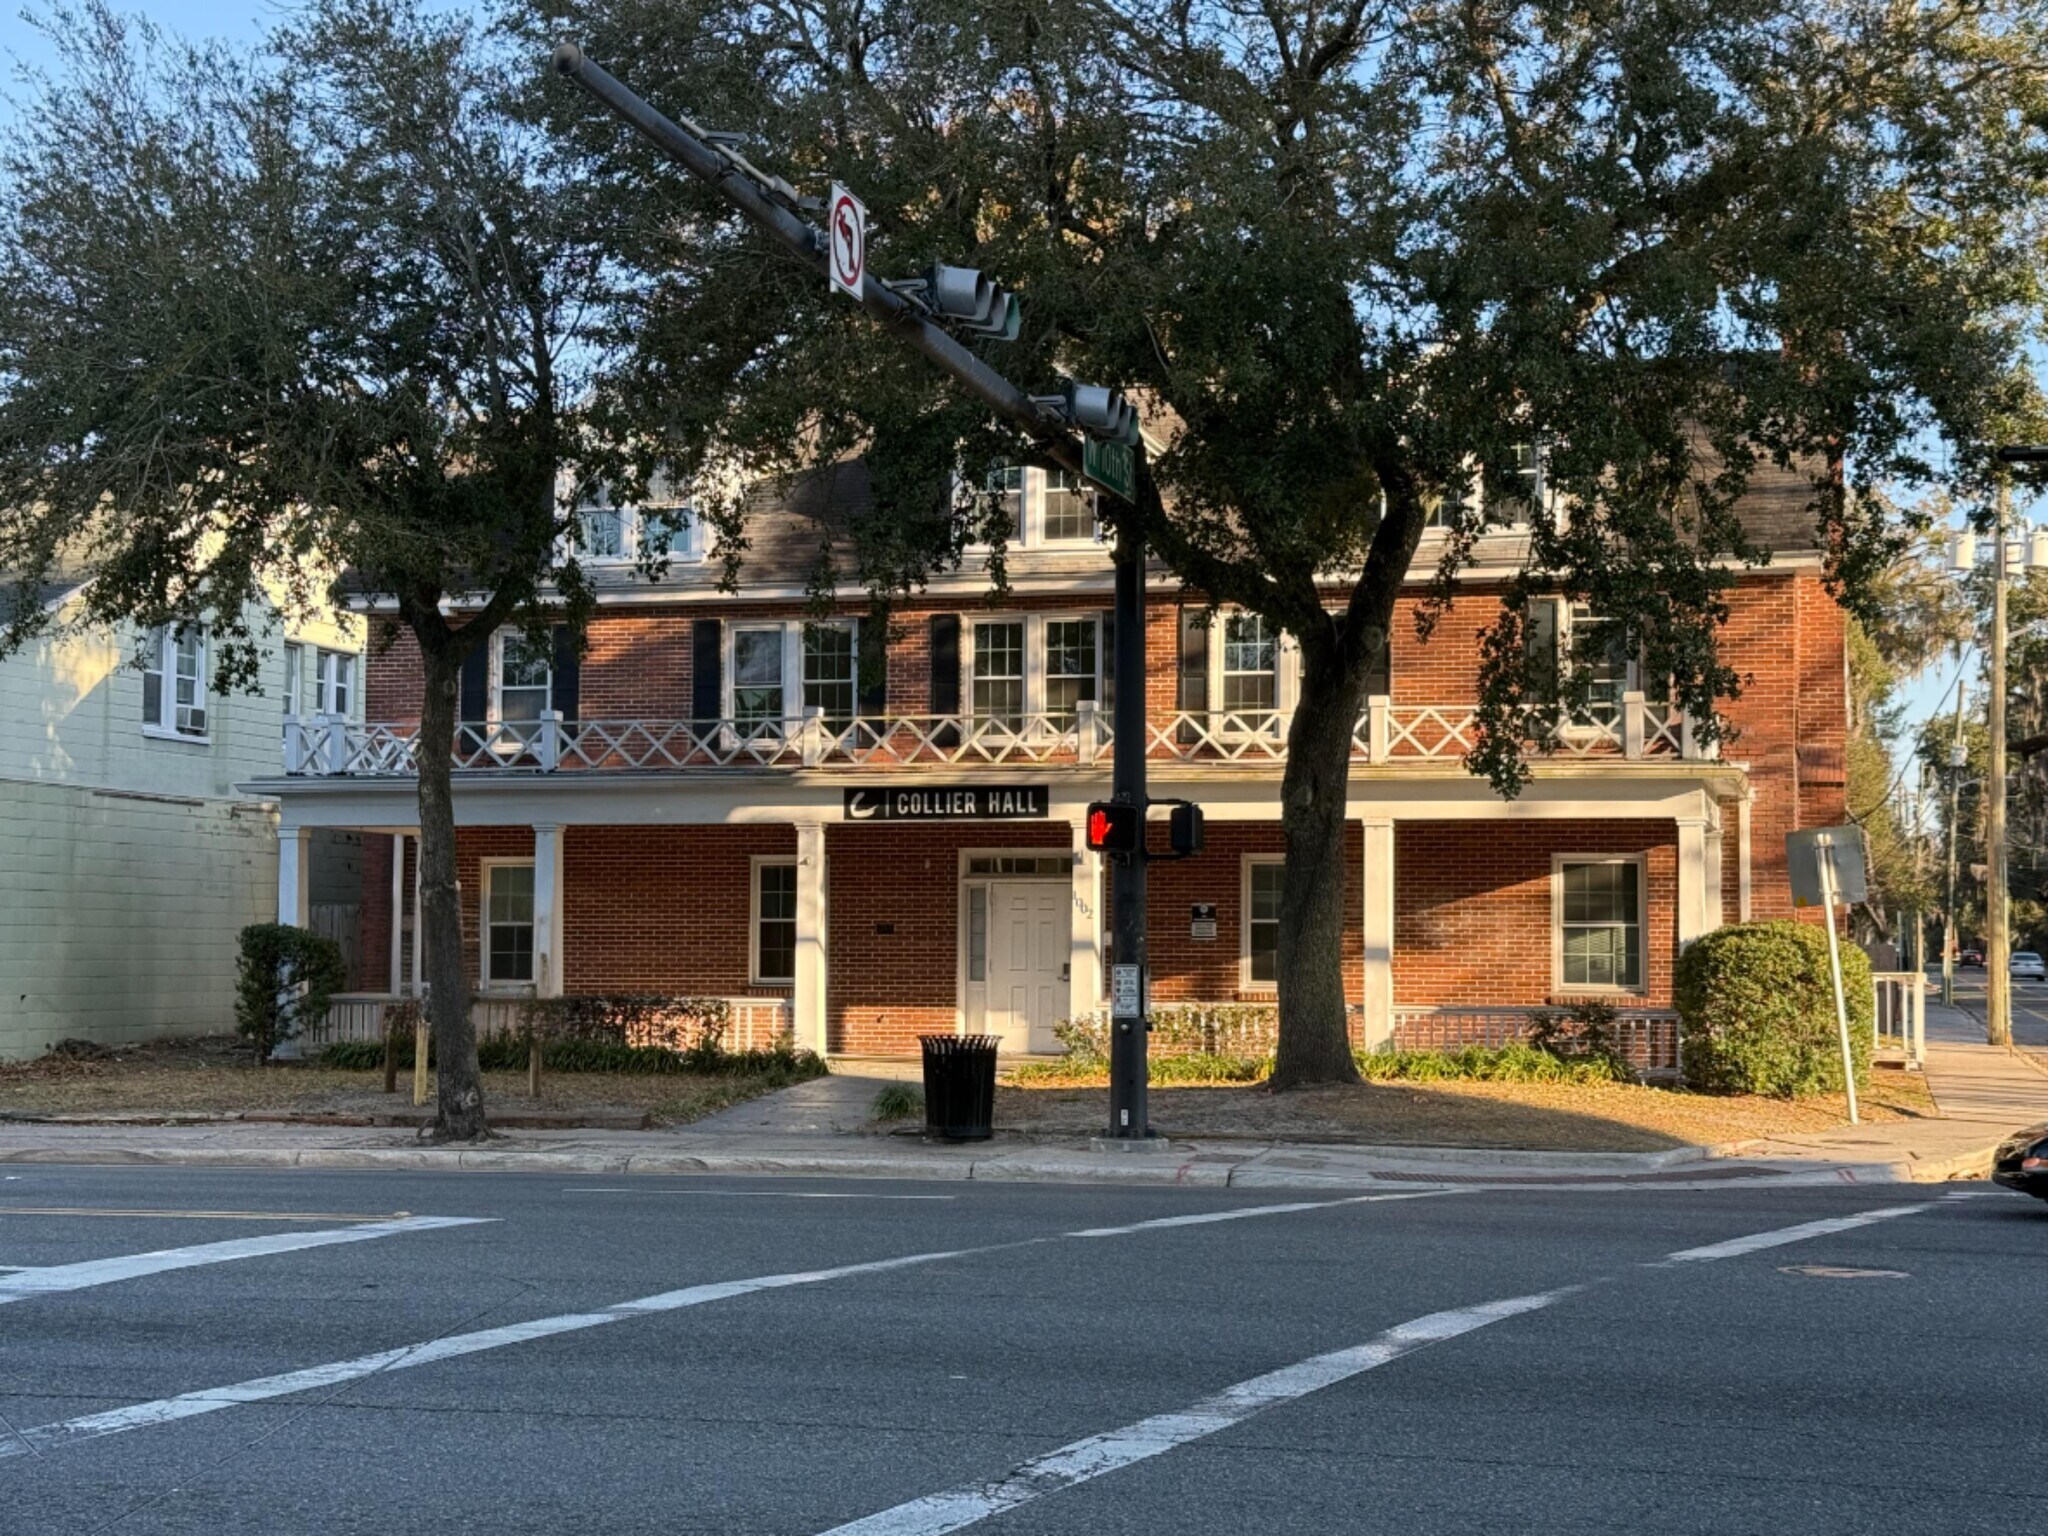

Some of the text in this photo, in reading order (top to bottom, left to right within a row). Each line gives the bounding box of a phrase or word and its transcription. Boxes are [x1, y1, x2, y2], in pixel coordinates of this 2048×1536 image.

[897, 791, 1038, 814] COLLIER HALL
[1073, 891, 1094, 919] 1002
